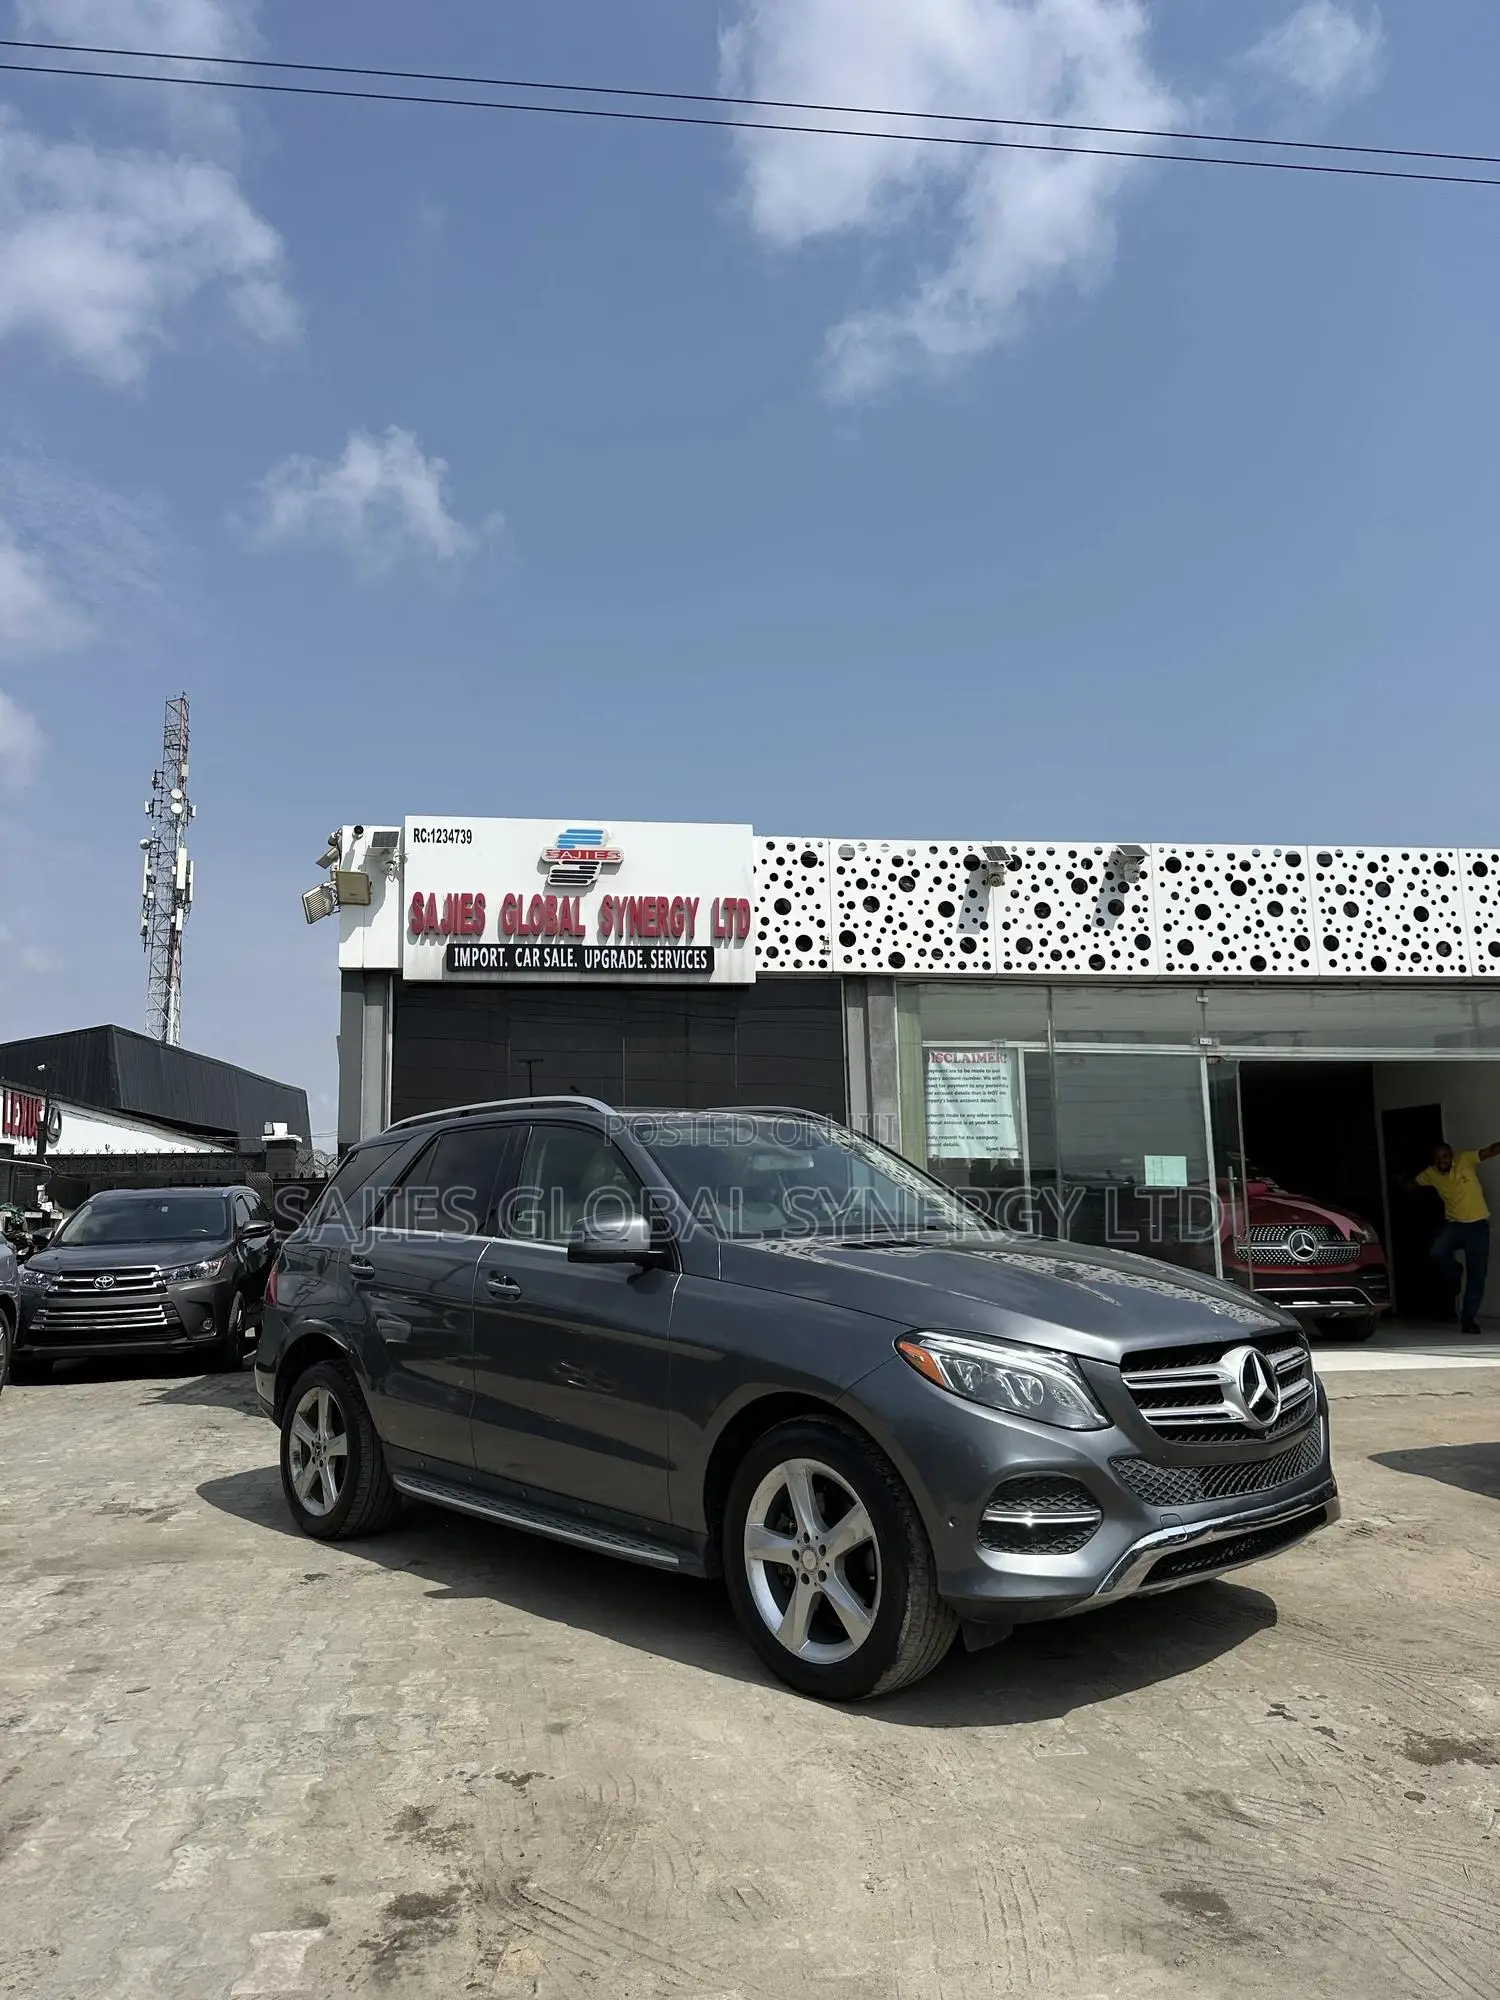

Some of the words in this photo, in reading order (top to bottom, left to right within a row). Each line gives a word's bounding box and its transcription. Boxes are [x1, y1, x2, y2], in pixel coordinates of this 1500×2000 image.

[412, 827, 473, 845] RC:1234739
[545, 849, 623, 860] SAJIES
[410, 891, 487, 936] SAJIES
[501, 892, 586, 938] GLOBAL
[599, 894, 701, 939] SYNERGY
[713, 896, 752, 940] LTD
[453, 946, 509, 968] IMPORT.
[584, 948, 648, 970] UPGRADE.
[650, 949, 708, 970] SERVICES
